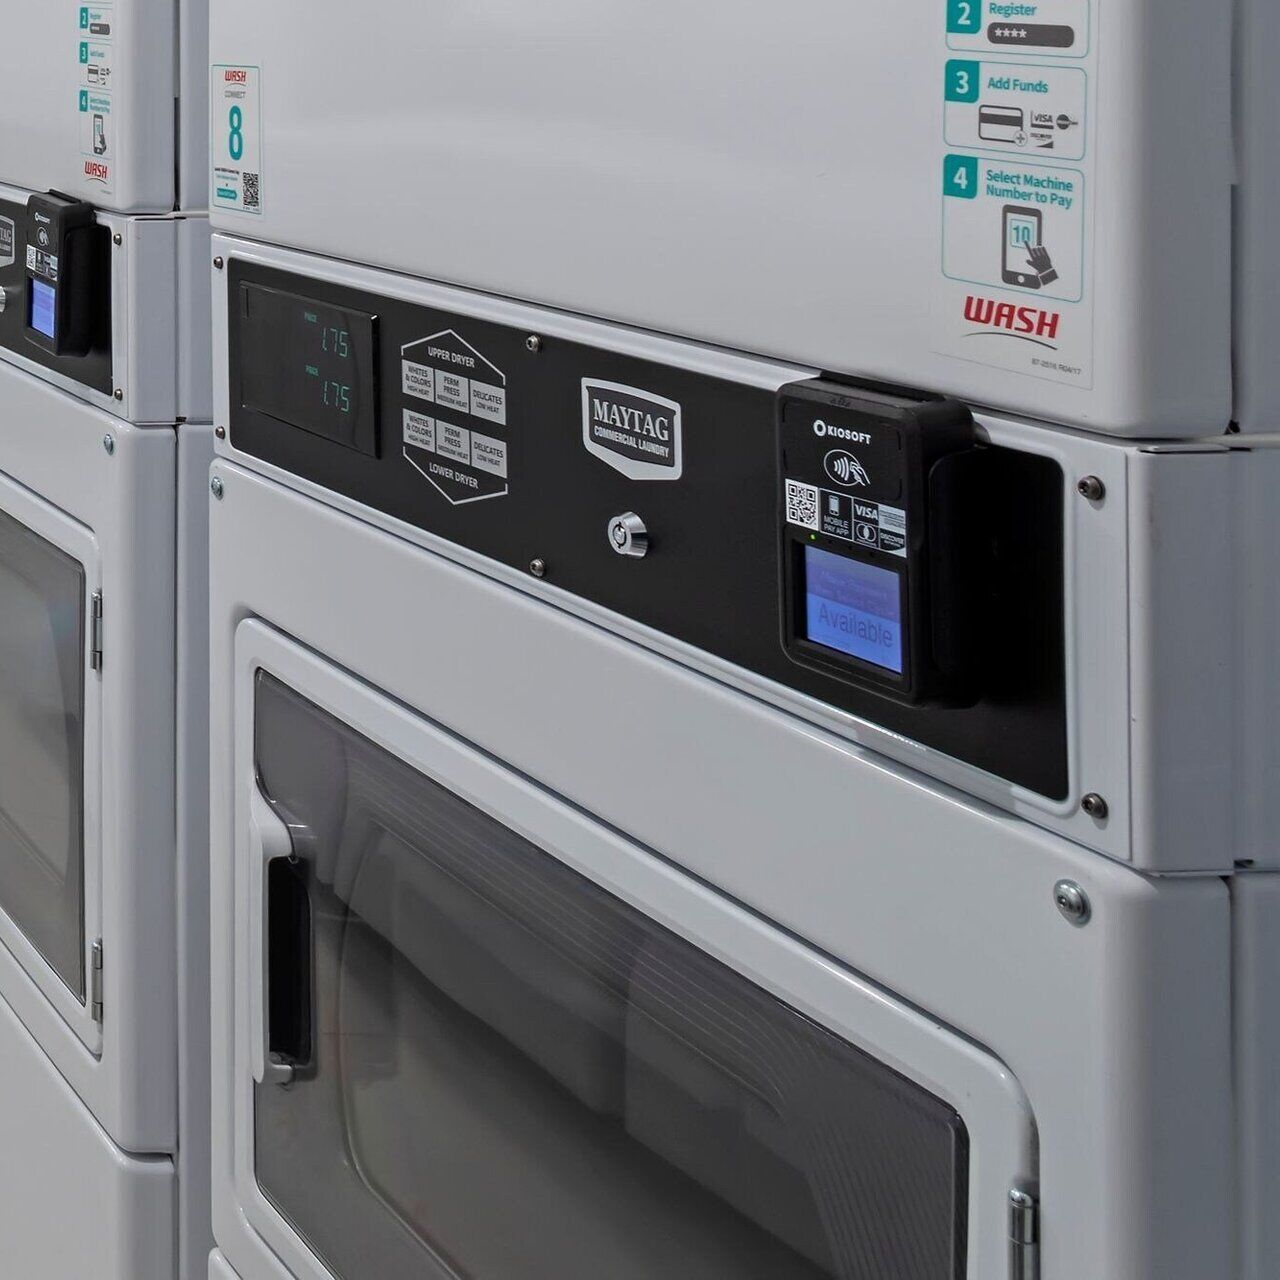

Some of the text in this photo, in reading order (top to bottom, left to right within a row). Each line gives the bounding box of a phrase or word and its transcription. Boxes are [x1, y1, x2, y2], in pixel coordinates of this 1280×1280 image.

[957, 2, 1038, 25] 2 Register
[224, 70, 246, 82] WASH
[956, 71, 1048, 94] 3 Add Funds
[1034, 113, 1054, 123] VISA
[228, 105, 243, 161] 8
[84, 161, 108, 178] WASH
[953, 167, 1074, 192] 4 Select Machine
[986, 184, 1072, 210] Number to Pay
[1012, 225, 1030, 243] 10
[964, 296, 1060, 339] WASH
[428, 346, 475, 368] UPPER DRYER
[408, 366, 428, 378] WHITES
[410, 376, 431, 388] COLORS
[444, 376, 459, 386] PERM
[443, 386, 460, 397] PRESS
[472, 390, 502, 405] DELICATES
[409, 415, 429, 428] WHITES
[593, 398, 669, 442] MAYTAG
[411, 425, 432, 438] COLORS
[444, 426, 460, 438] PERM
[827, 426, 871, 445] KIOSOFT
[444, 436, 461, 448] PRESS
[474, 441, 504, 458] DELICATES
[594, 425, 670, 458] COMMERCIAL LAUNDRY
[429, 462, 478, 489] LOWER DRYER
[854, 504, 878, 520] VISA
[823, 515, 849, 528] MOBILE
[824, 524, 849, 536] PAY APP
[818, 604, 893, 648] Available
